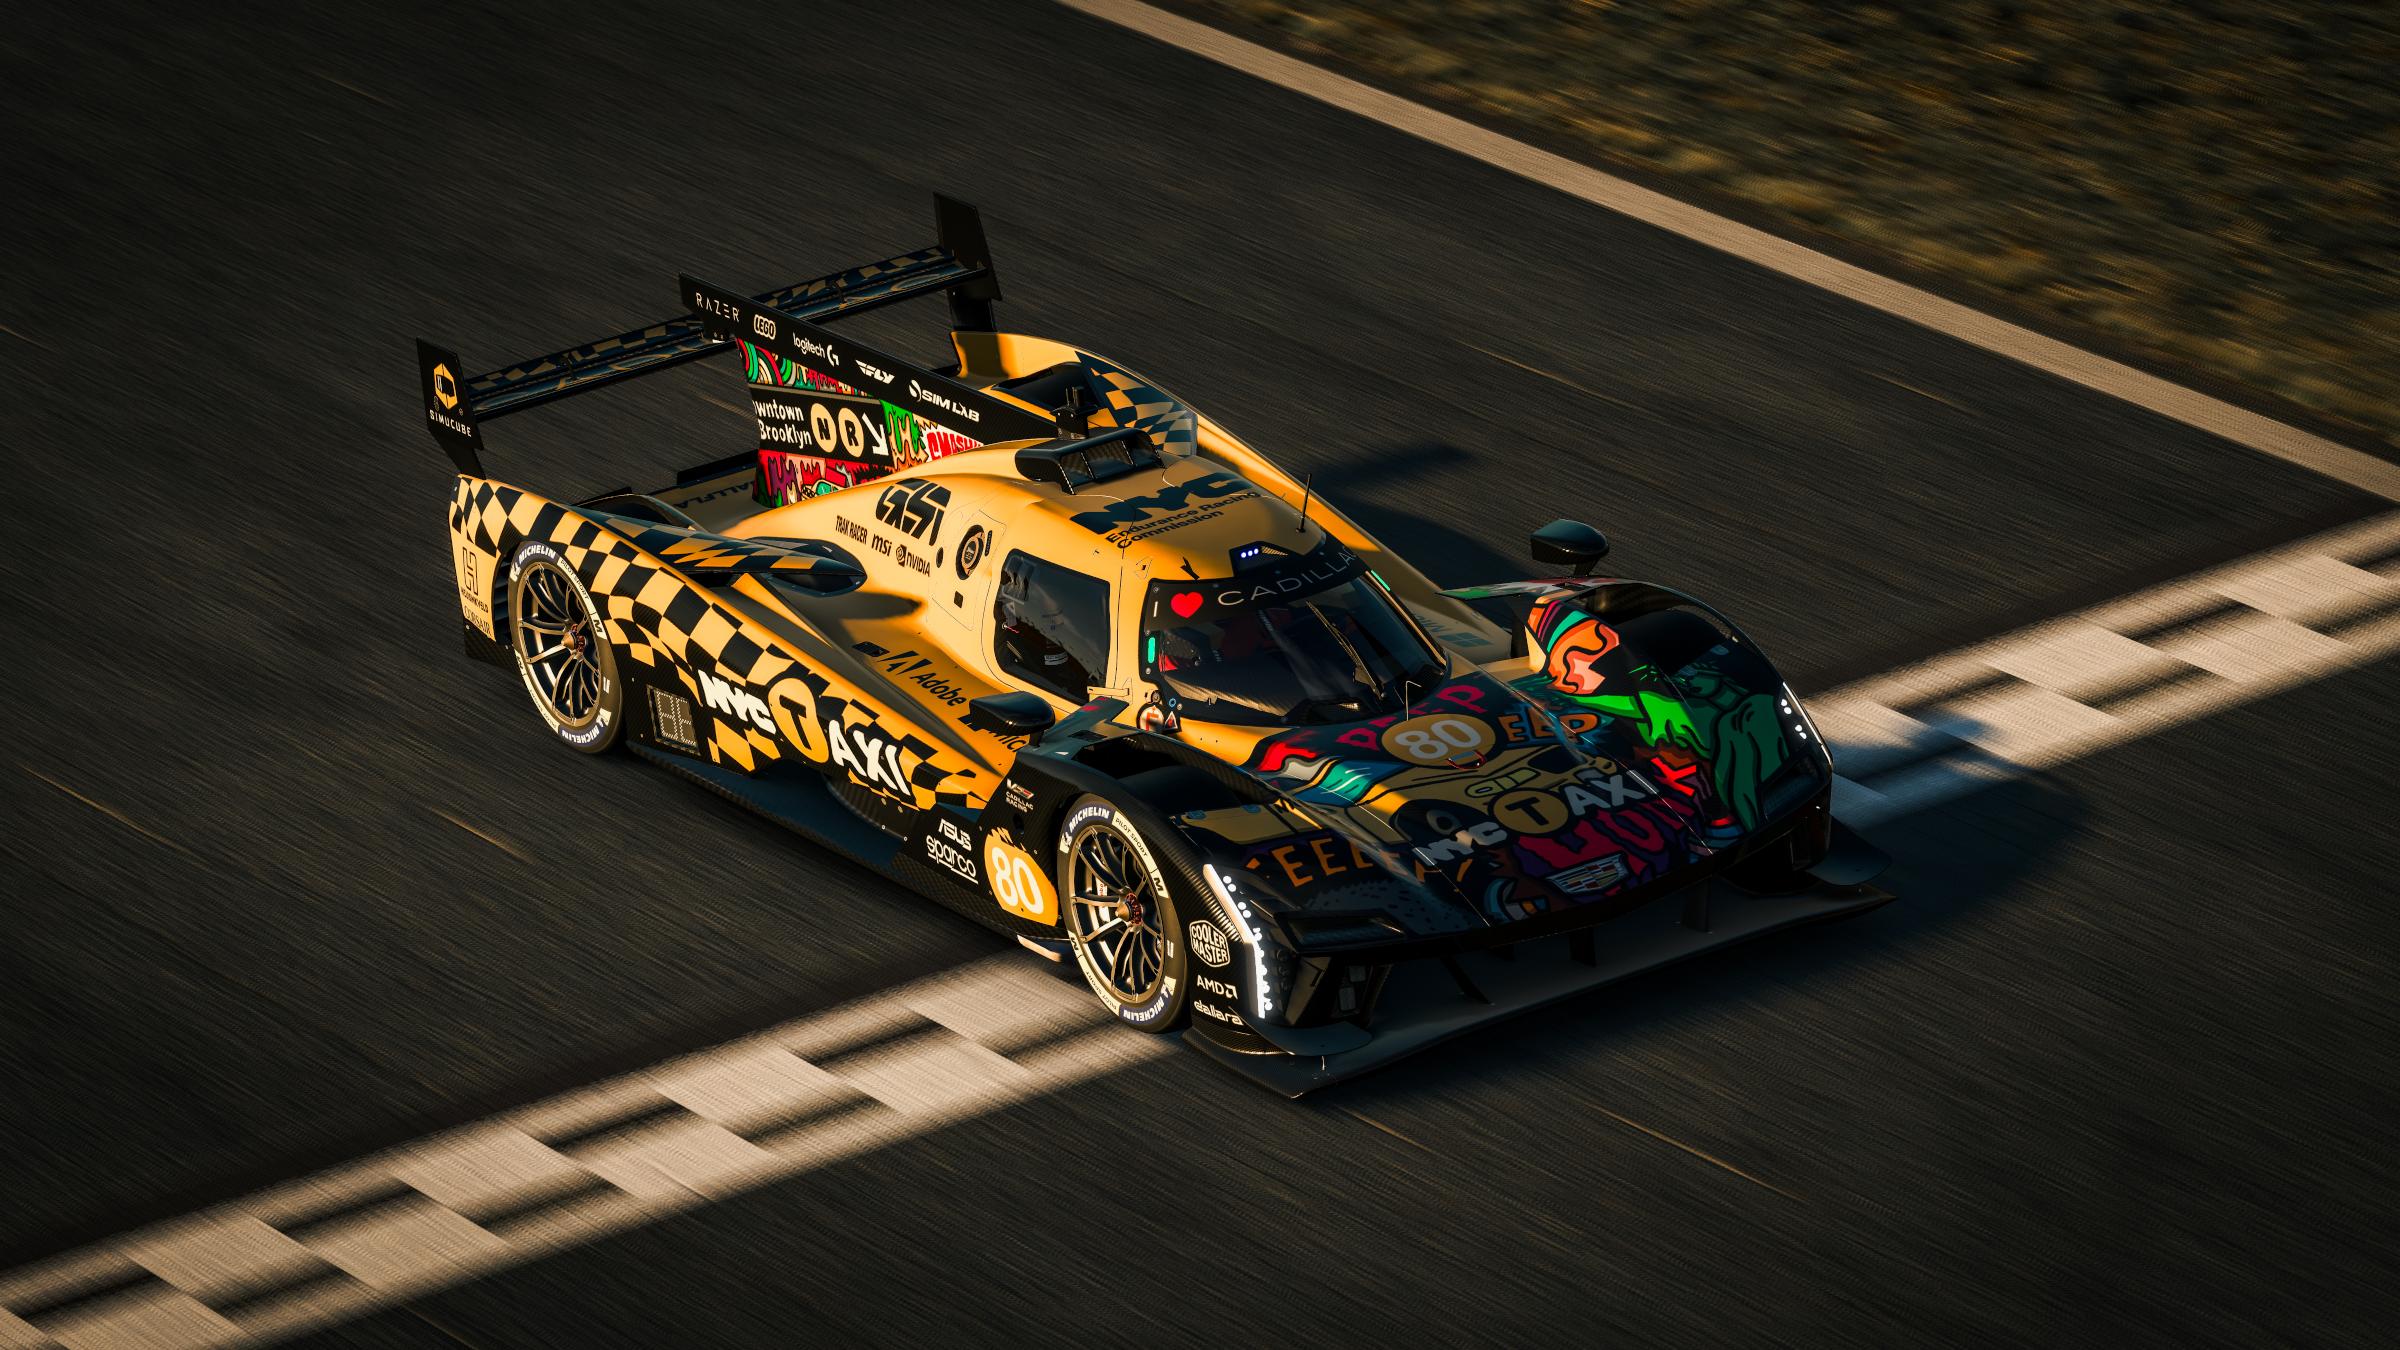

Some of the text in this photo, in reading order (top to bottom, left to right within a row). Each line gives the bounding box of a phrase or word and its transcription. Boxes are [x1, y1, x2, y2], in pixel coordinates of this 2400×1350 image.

[695, 292, 740, 323] RAZER
[754, 315, 775, 339] LEGO
[793, 332, 826, 359] logitech
[921, 389, 951, 411] SIM
[429, 409, 472, 437] SIMUCUBE
[1069, 472, 1252, 535] NYC
[1105, 491, 1261, 543] Endurance Racing
[1116, 510, 1224, 549] Commission
[518, 544, 556, 565] MICHELIN
[871, 533, 893, 557] msi
[697, 669, 777, 735] NYC
[909, 673, 969, 707] Adobe
[561, 725, 600, 744] MICHELIN
[1394, 719, 1482, 759] 80
[1006, 791, 1034, 811] CADILLAC
[1068, 806, 1110, 833] MICHELIN
[938, 818, 972, 852] ASUS
[1115, 817, 1148, 857] PILOT SPORT
[1412, 821, 1507, 866] NYC
[926, 834, 976, 878] sparco
[992, 846, 1044, 915] 80
[1191, 924, 1226, 950] COOLER
[1192, 939, 1228, 964] MASTER
[1196, 974, 1225, 995] AMD
[1123, 997, 1165, 1022] MICHELIN
[1193, 1000, 1244, 1026] dallara
